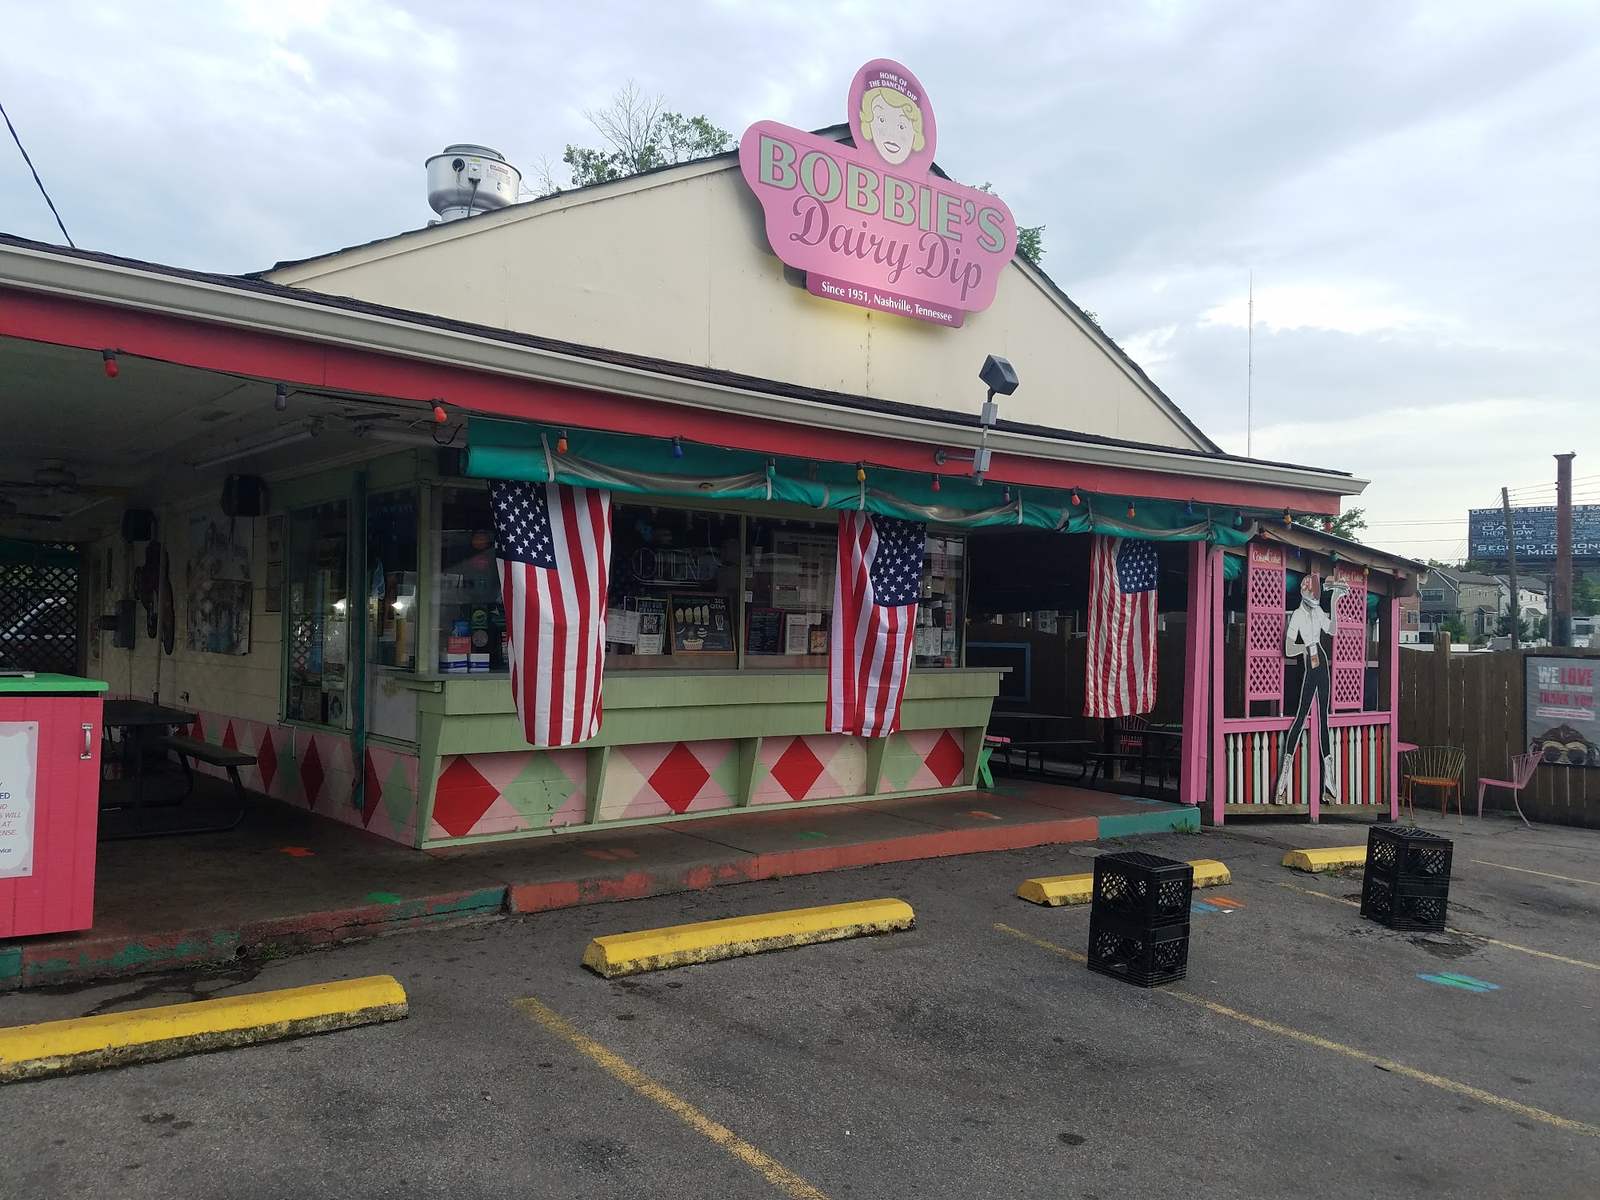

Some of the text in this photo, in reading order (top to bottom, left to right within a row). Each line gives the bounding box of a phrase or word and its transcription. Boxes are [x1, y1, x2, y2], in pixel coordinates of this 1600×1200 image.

[869, 79, 881, 88] THE
[906, 90, 918, 101] DIP
[879, 72, 908, 87] HOME OF
[758, 134, 1006, 253] BOBBIE'S
[789, 194, 982, 302] Dairy Dip
[821, 281, 953, 322] Since 1951, Nashville, Tennessee
[1537, 666, 1593, 686] WE LOVE
